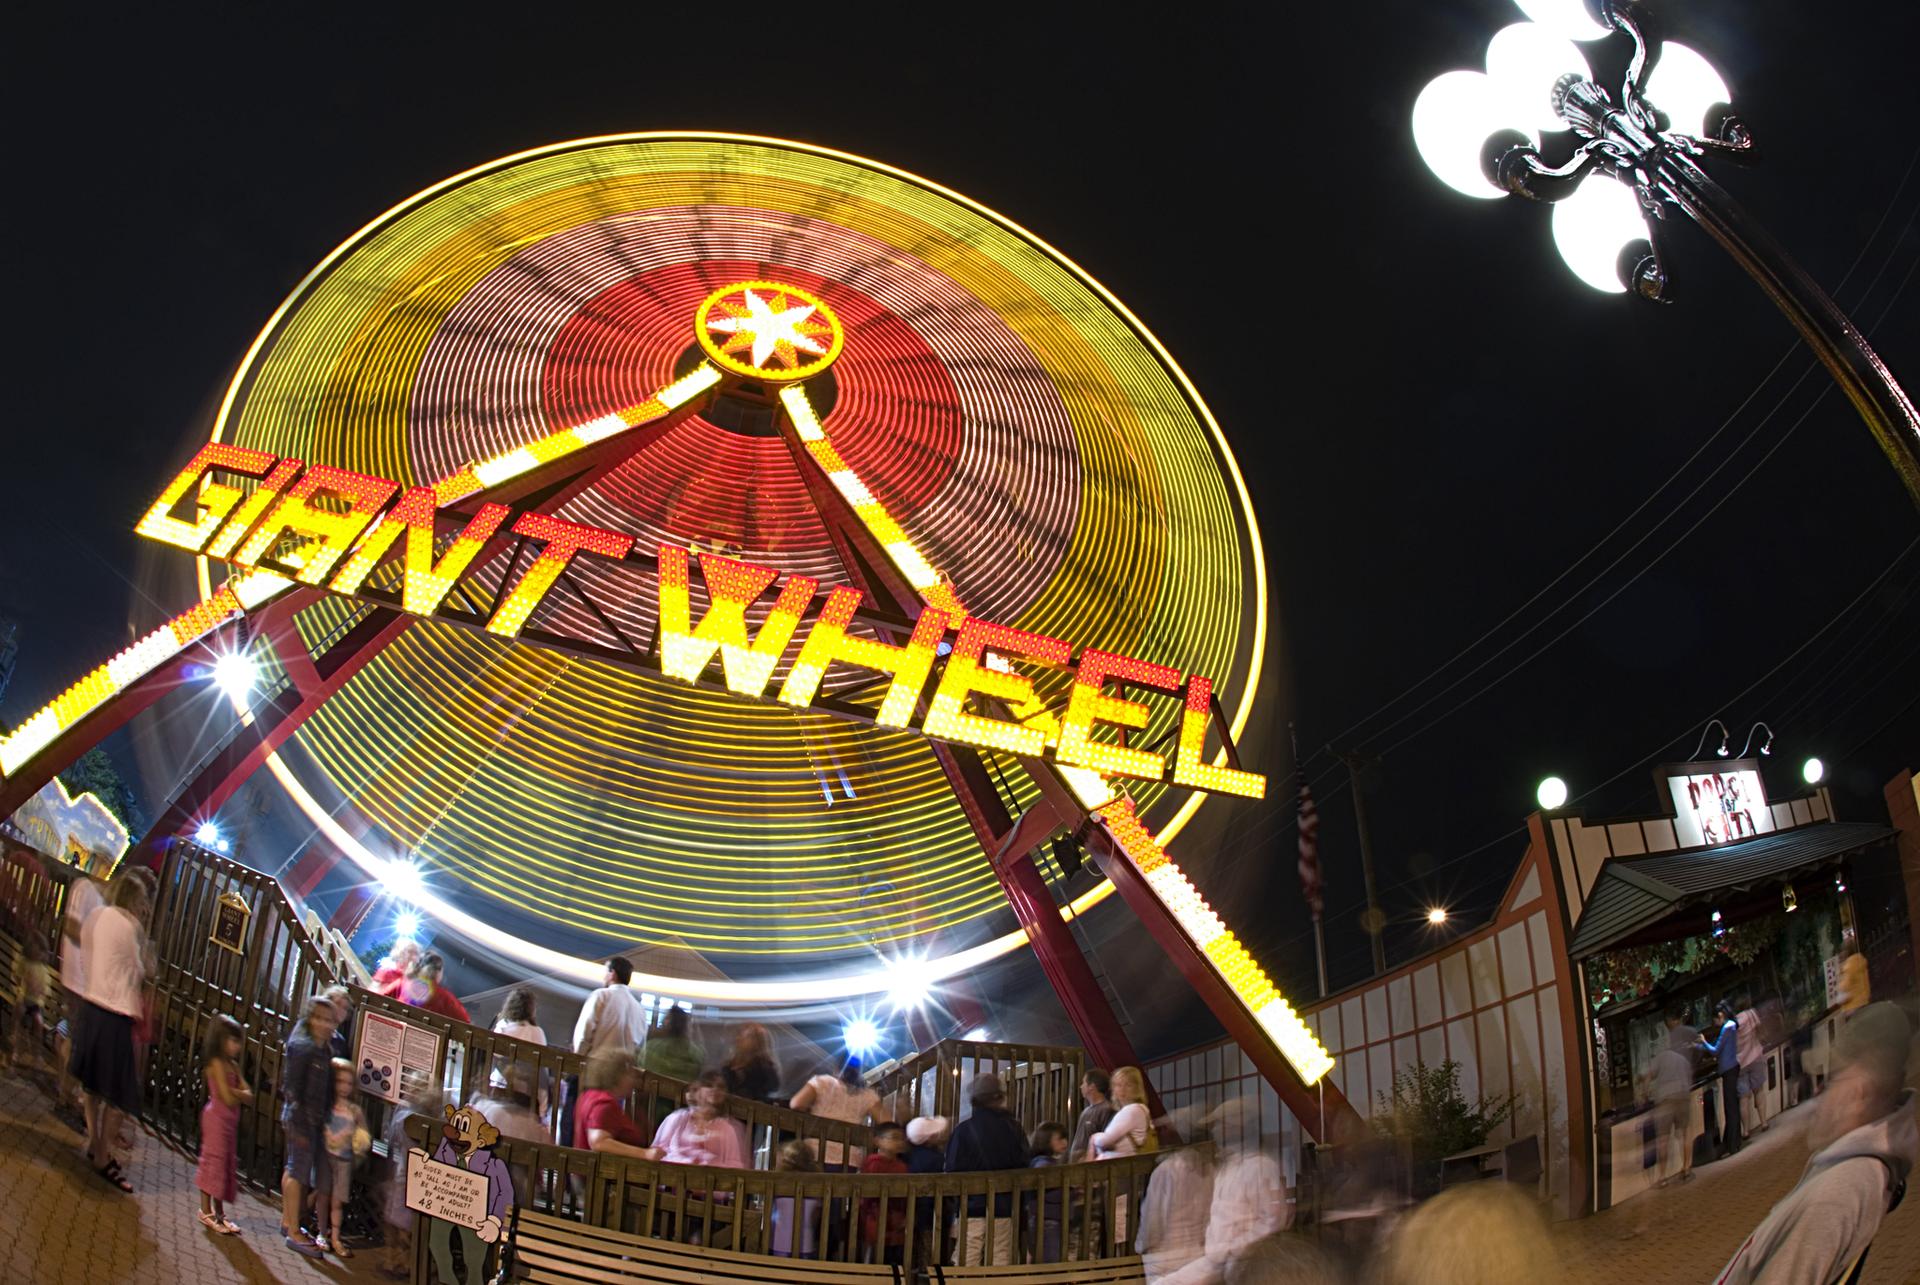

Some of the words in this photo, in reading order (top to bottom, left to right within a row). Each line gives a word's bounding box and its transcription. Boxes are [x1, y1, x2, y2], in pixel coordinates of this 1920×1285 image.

[134, 442, 637, 639] GIANT
[658, 543, 1266, 800] WHEEL
[426, 1174, 439, 1184] TALL
[446, 1173, 462, 1182] MUST
[465, 1177, 473, 1185] BE
[421, 1180, 429, 1188] BE
[433, 1185, 474, 1203] ACCOMPANIED
[418, 1197, 433, 1210] 48
[439, 1205, 474, 1224] INCHES
